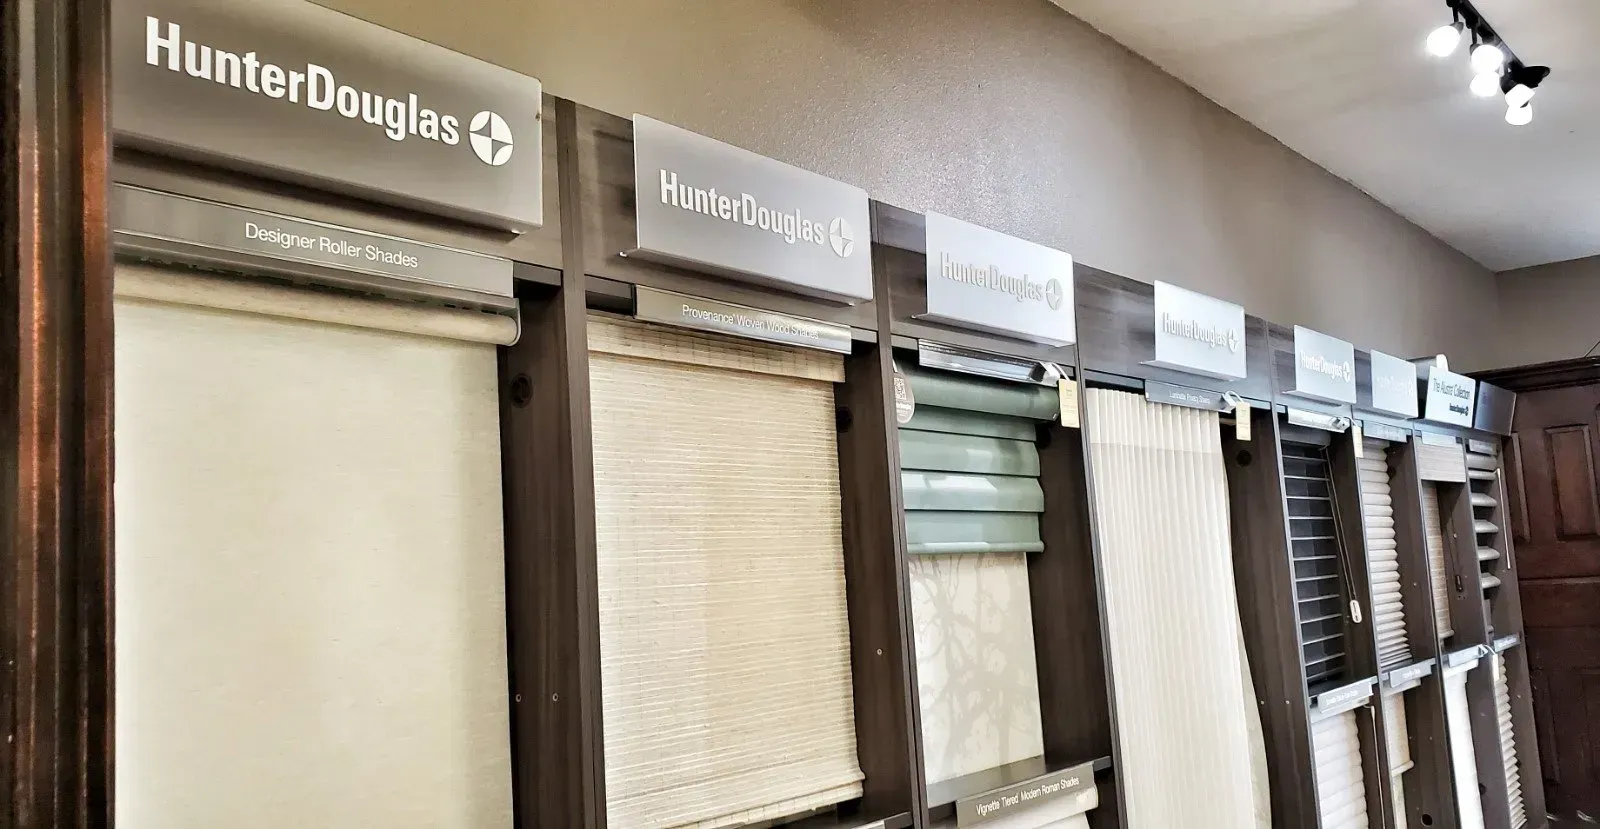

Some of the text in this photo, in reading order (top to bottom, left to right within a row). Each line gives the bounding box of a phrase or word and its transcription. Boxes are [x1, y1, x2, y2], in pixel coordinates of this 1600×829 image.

[146, 15, 460, 146] HunterDouglas
[659, 169, 825, 246] HunterDouglas
[245, 222, 419, 268] Designer Roller Shades
[941, 252, 1043, 302] HunterDouglas
[737, 315, 765, 330] Woven
[767, 321, 789, 334] Wood
[1020, 787, 1042, 802] Modern
[1042, 782, 1061, 795] Roman
[1061, 776, 1080, 789] Shades
